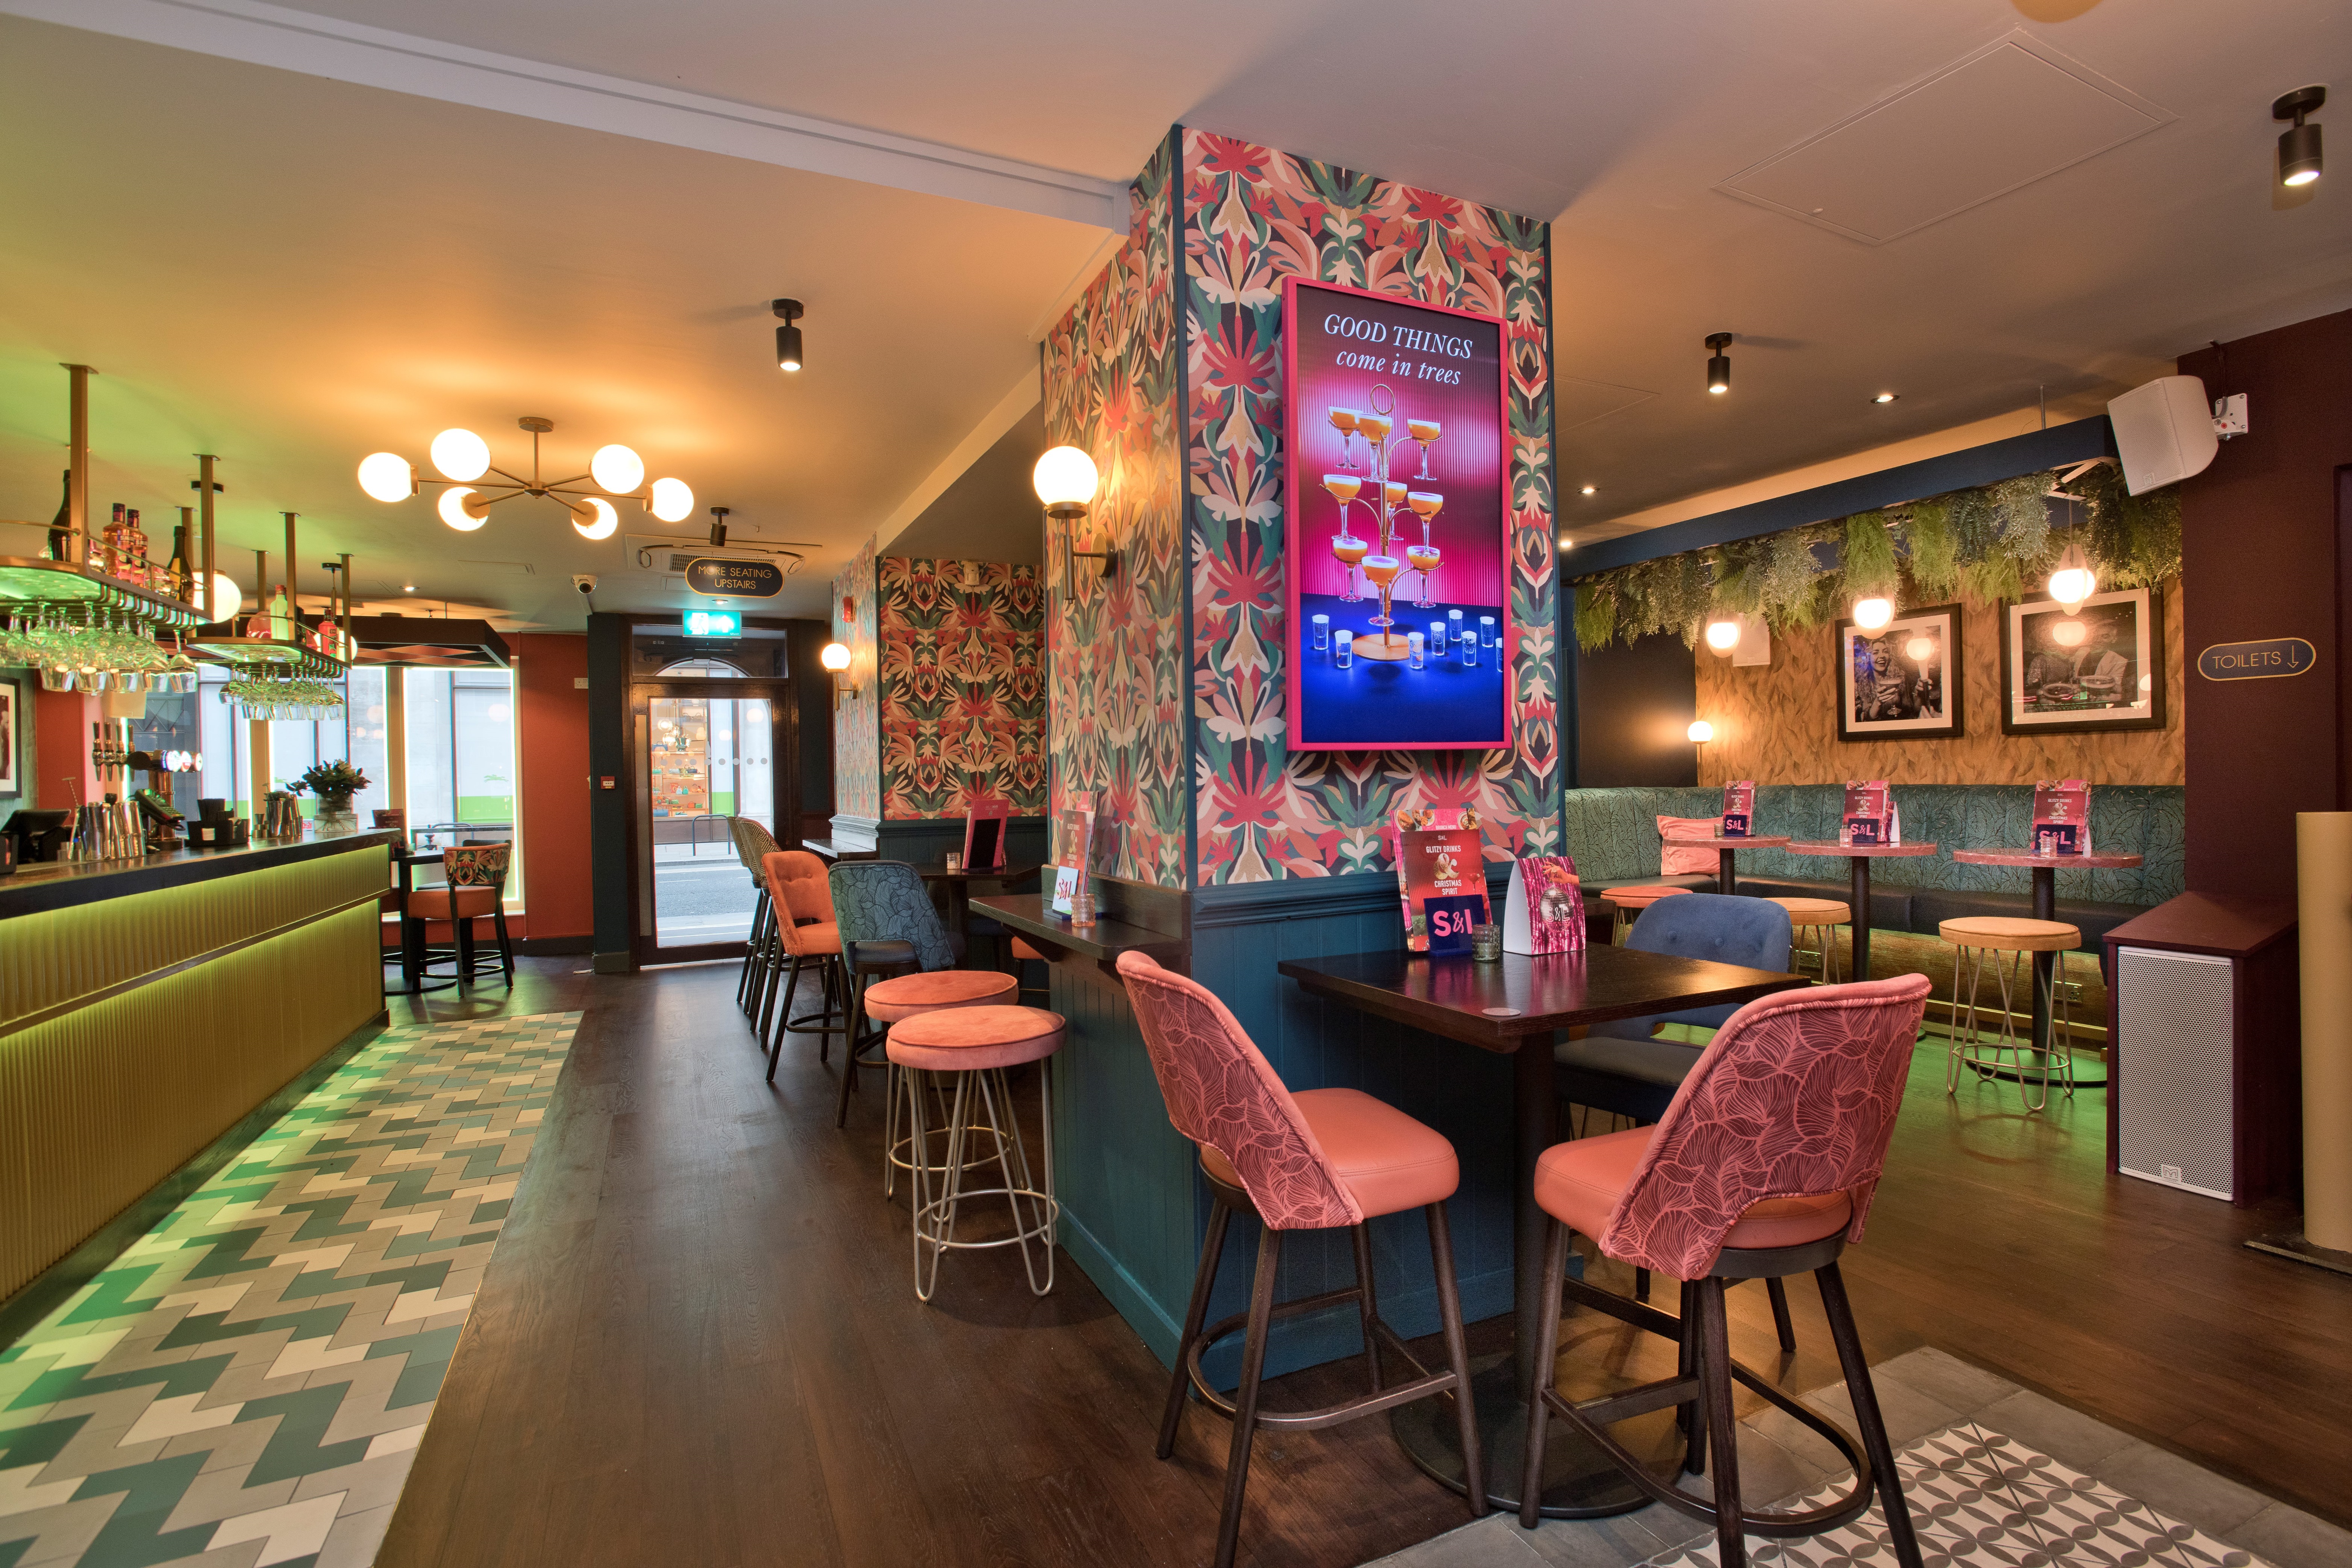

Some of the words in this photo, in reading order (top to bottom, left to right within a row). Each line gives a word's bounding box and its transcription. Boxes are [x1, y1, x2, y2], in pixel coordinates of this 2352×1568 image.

[1325, 314, 1387, 342] GOOD
[1393, 326, 1473, 359] THINGS
[1337, 351, 1386, 372] come
[1392, 353, 1411, 376] in
[1418, 362, 1461, 385] trees
[698, 566, 726, 576] MORE
[730, 568, 772, 578] SEATING
[715, 579, 756, 589] UPSTAIRS
[2212, 651, 2282, 669] TOILETS
[1726, 820, 1743, 830] S&L
[1850, 824, 1875, 835] S&L
[1545, 904, 1570, 922] S&L
